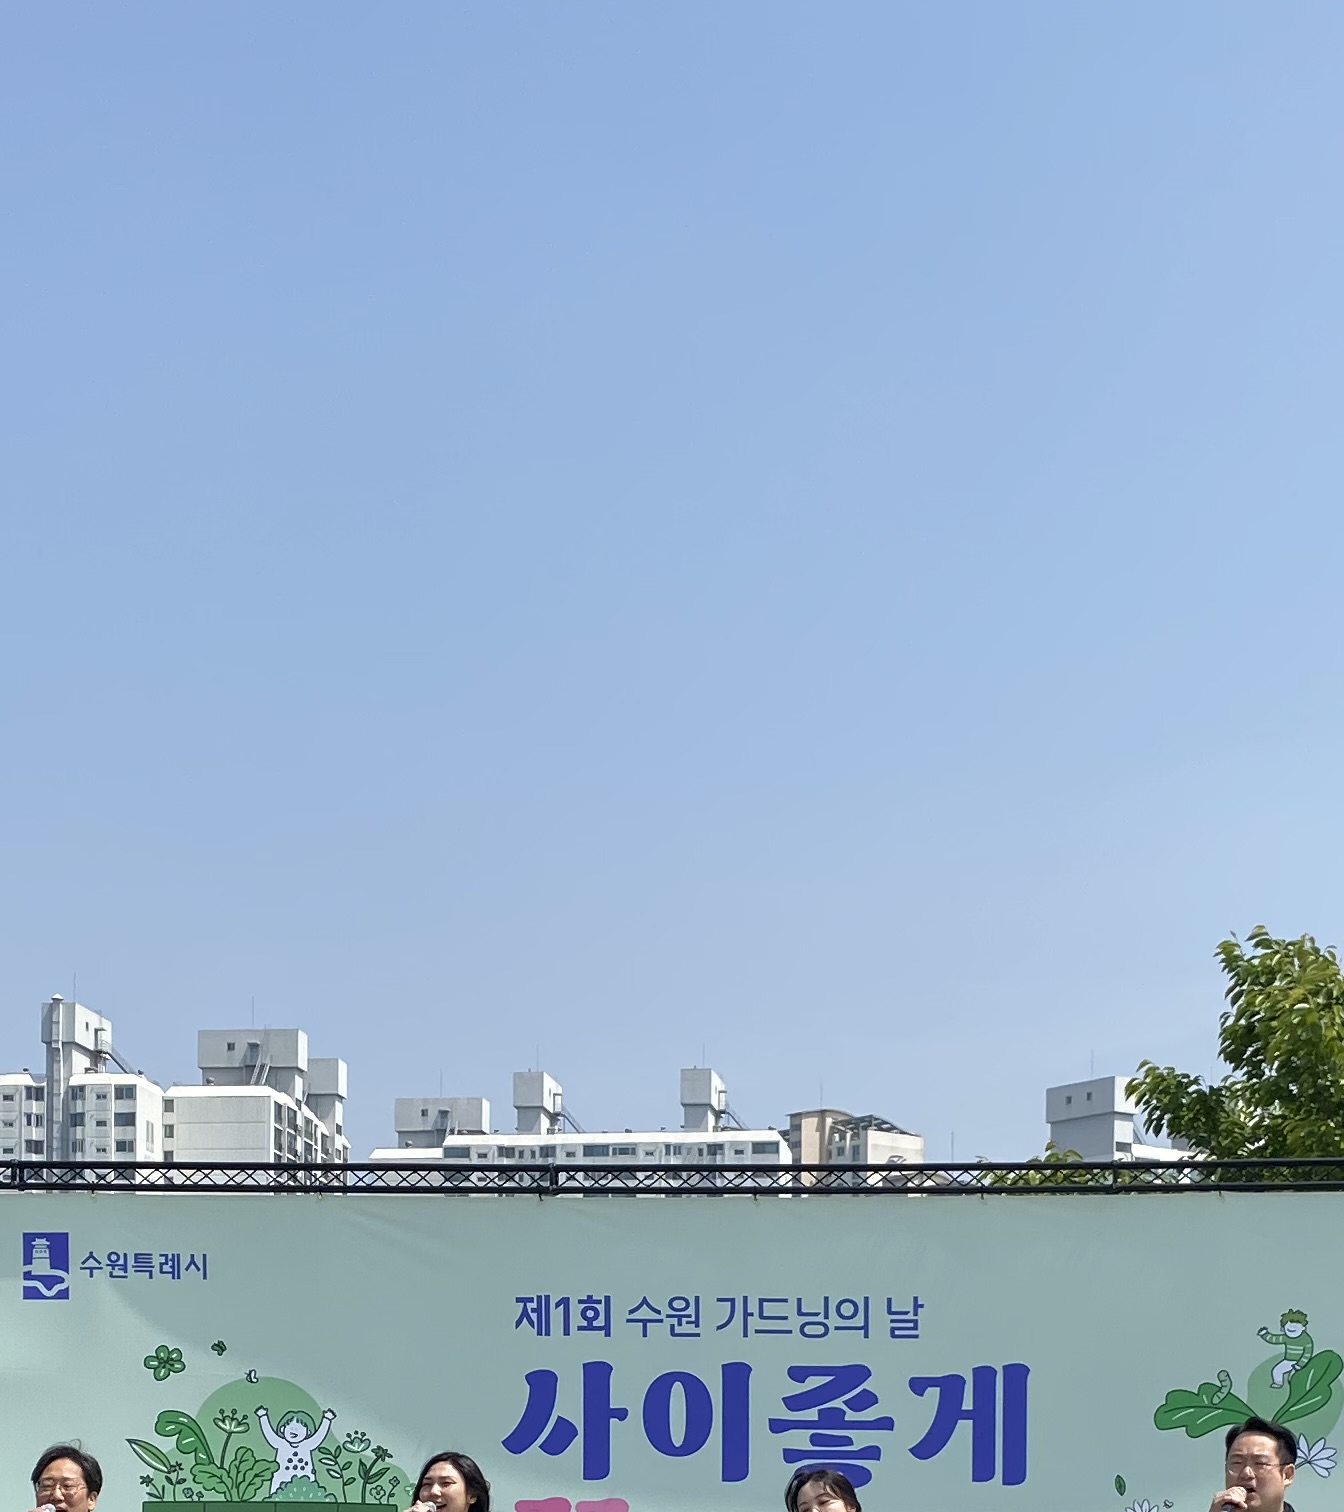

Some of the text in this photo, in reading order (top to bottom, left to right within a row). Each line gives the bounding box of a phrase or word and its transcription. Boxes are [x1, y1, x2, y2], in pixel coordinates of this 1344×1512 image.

[79, 1250, 208, 1281] 수원특례시
[514, 1294, 925, 1339] 제1회 수원 가드닝의 날
[501, 1360, 1031, 1489] 사이좋게
